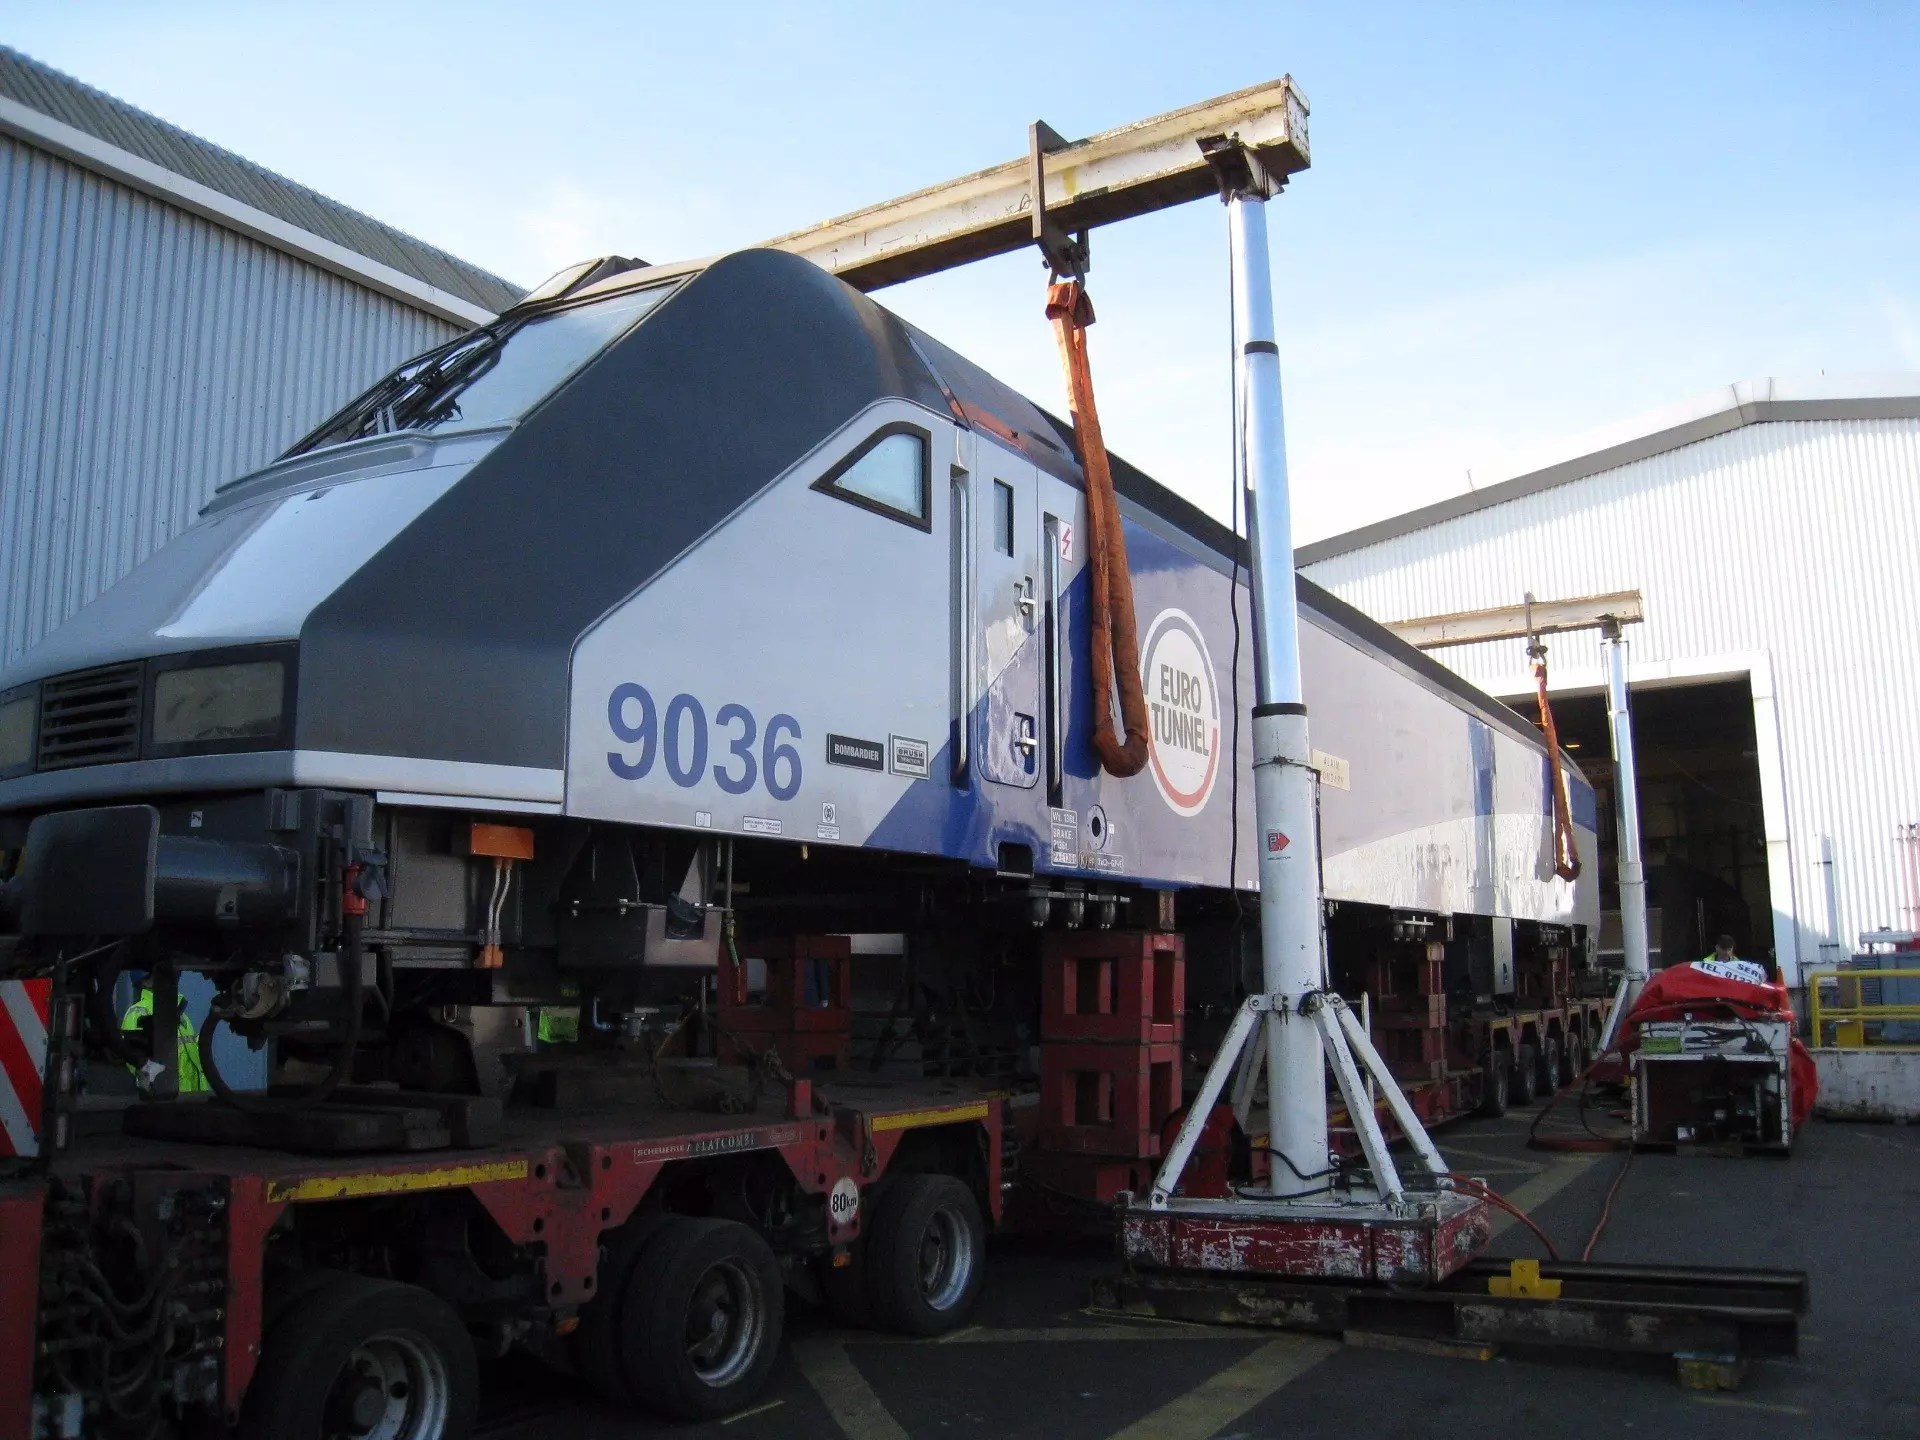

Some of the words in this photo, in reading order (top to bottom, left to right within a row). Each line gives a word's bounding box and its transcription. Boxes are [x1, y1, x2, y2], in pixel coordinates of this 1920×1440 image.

[1160, 663, 1202, 714] EURO
[607, 682, 803, 802] 9036
[834, 743, 880, 762] BOMBARDIER
[1151, 702, 1209, 757] TUNNEL
